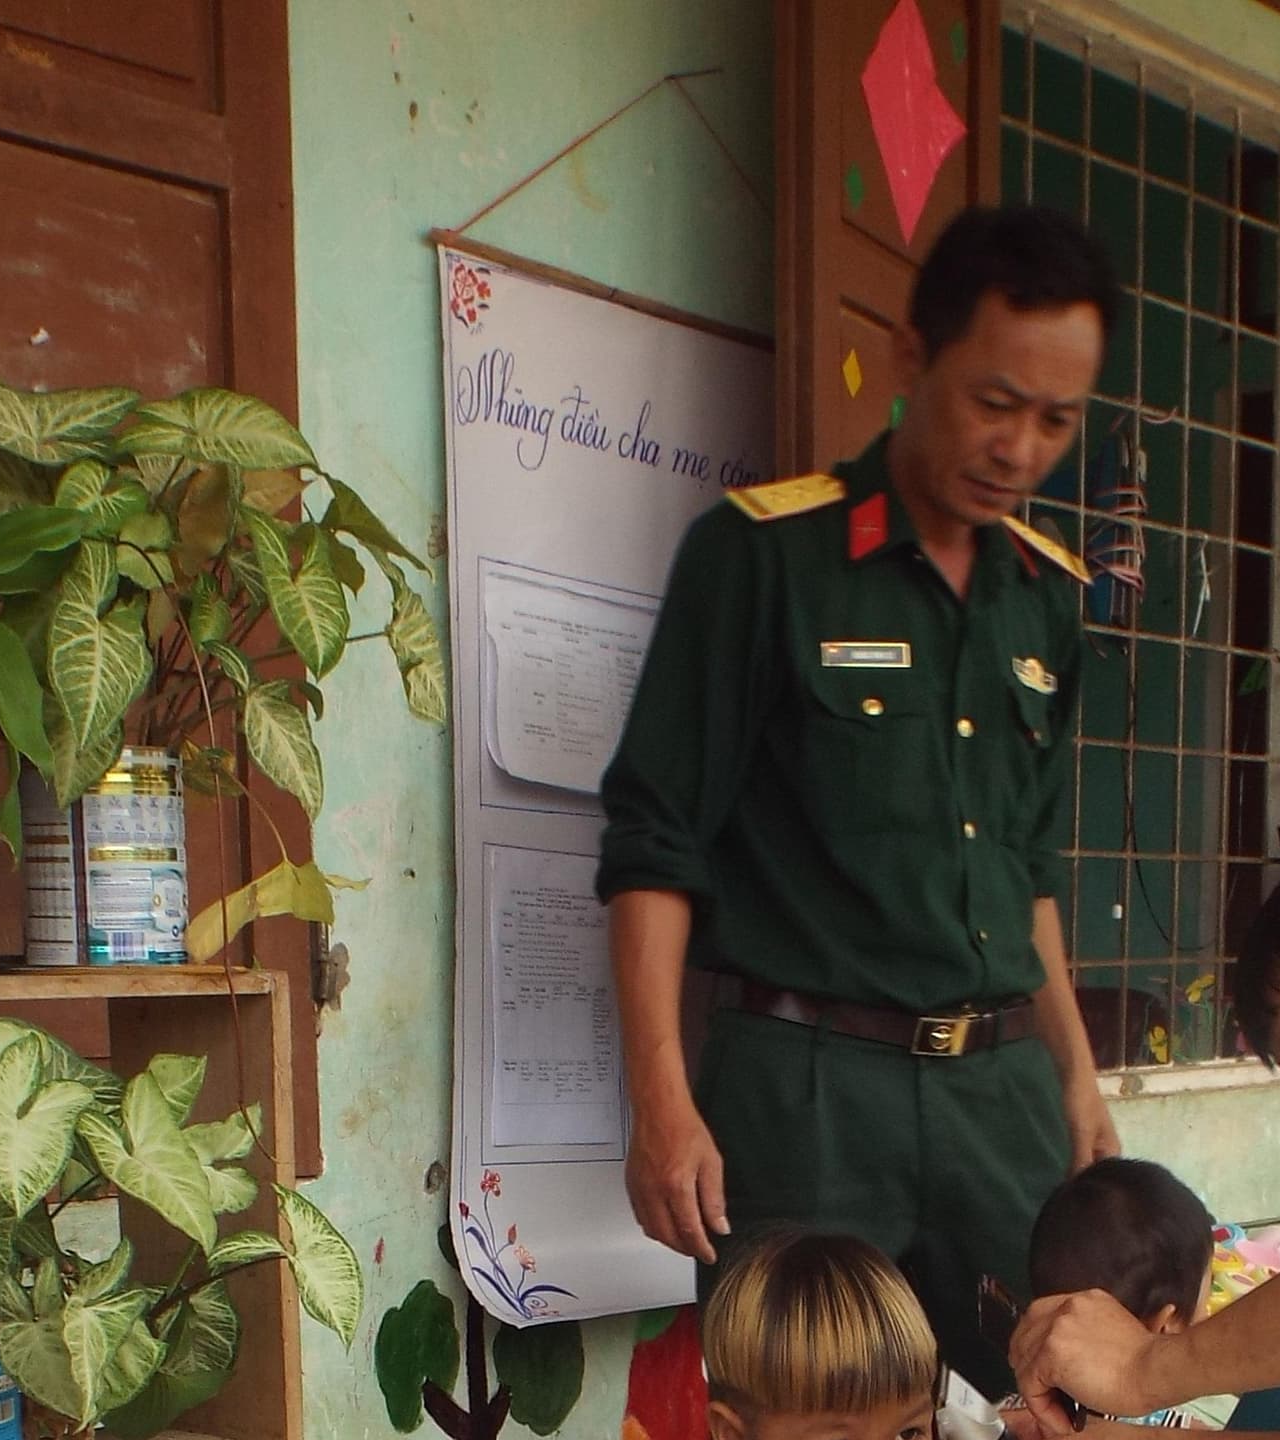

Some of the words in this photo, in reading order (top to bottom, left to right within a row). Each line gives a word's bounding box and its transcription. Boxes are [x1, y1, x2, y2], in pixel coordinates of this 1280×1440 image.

[456, 348, 554, 471] Những
[560, 384, 612, 451] điều
[619, 400, 661, 467] cha
[671, 447, 711, 489] mẹ
